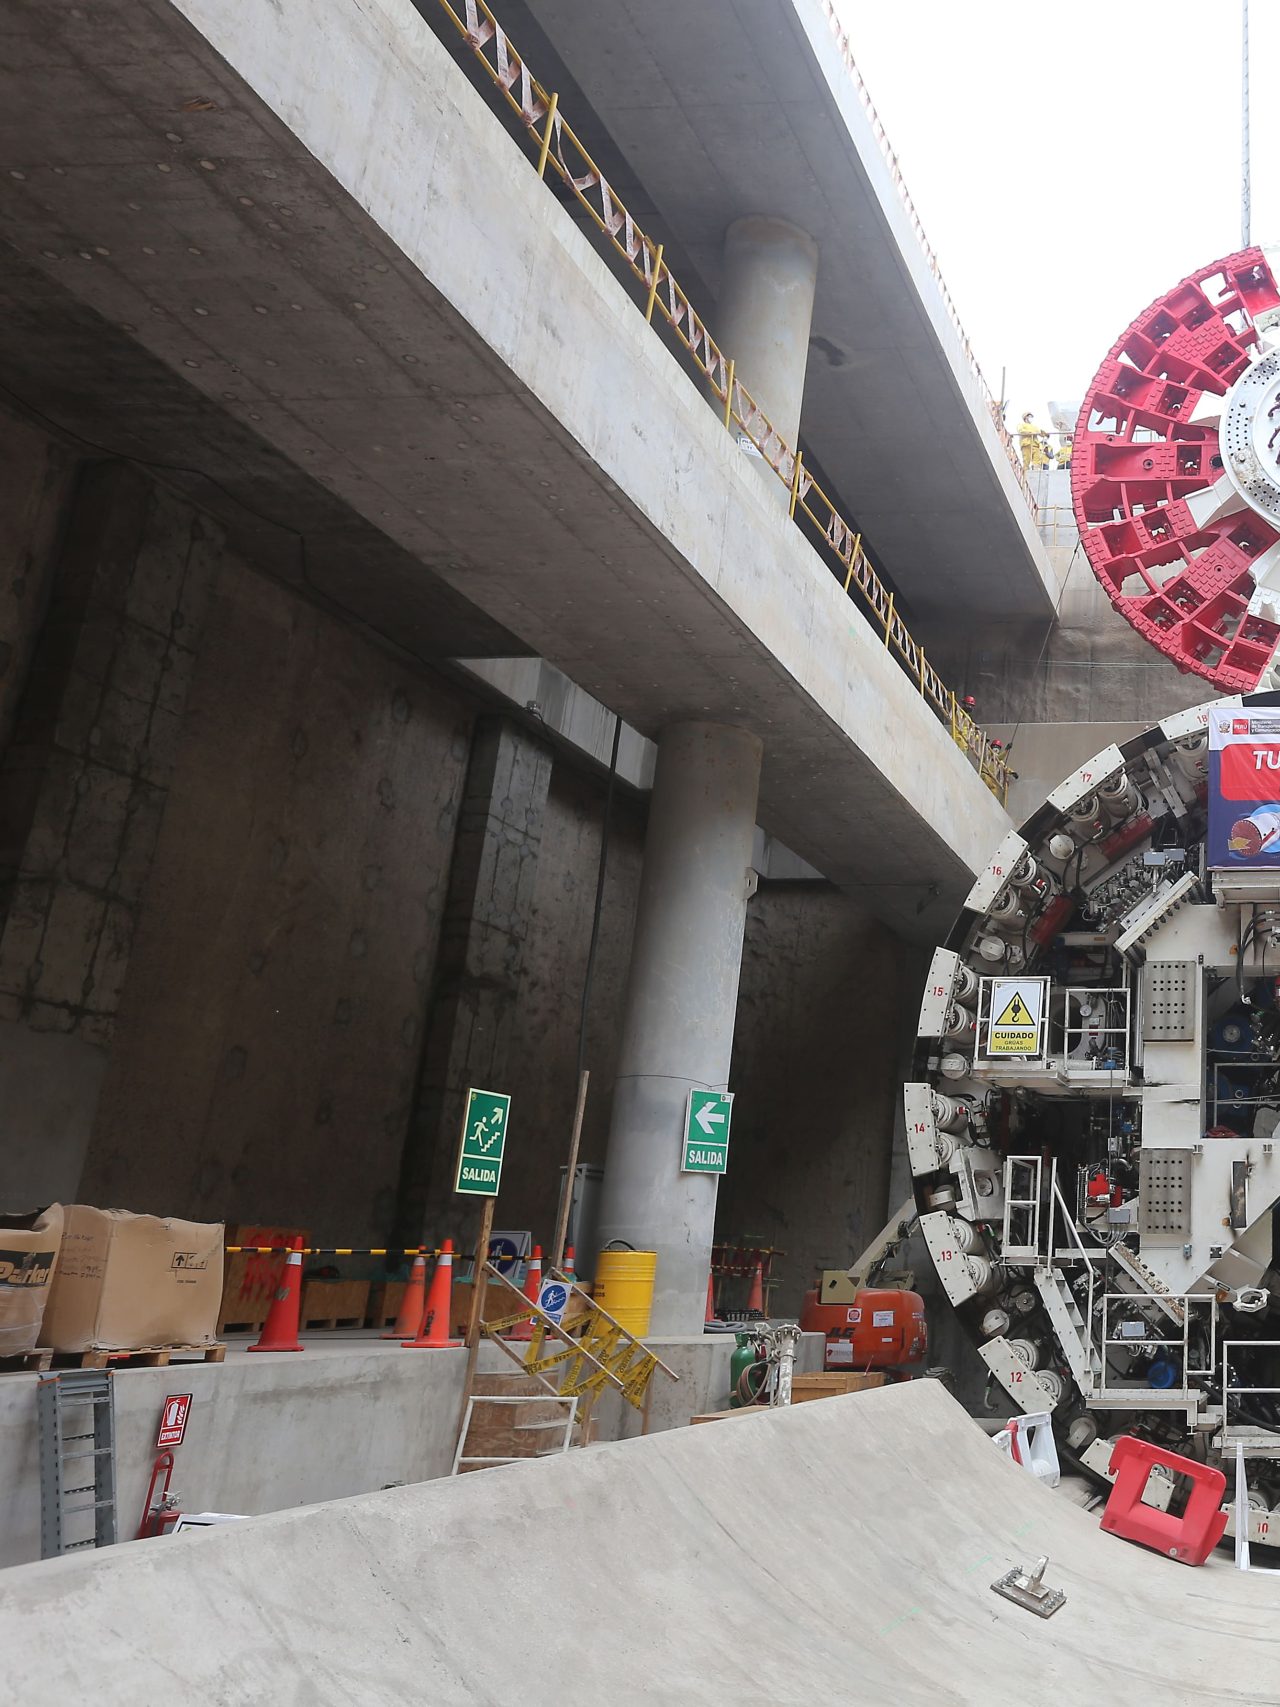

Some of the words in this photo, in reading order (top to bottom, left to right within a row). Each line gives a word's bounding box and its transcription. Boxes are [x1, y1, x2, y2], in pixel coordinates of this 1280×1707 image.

[1196, 714, 1208, 724] 18
[1082, 773, 1092, 783] 17
[992, 866, 1002, 876] 16
[933, 986, 944, 997] 15
[914, 1122, 925, 1134] 14
[688, 1149, 723, 1166] SALIDA
[462, 1166, 496, 1183] SALIDA
[941, 1250, 952, 1262] 13
[1011, 1371, 1022, 1383] 12
[1258, 1522, 1269, 1534] 10
